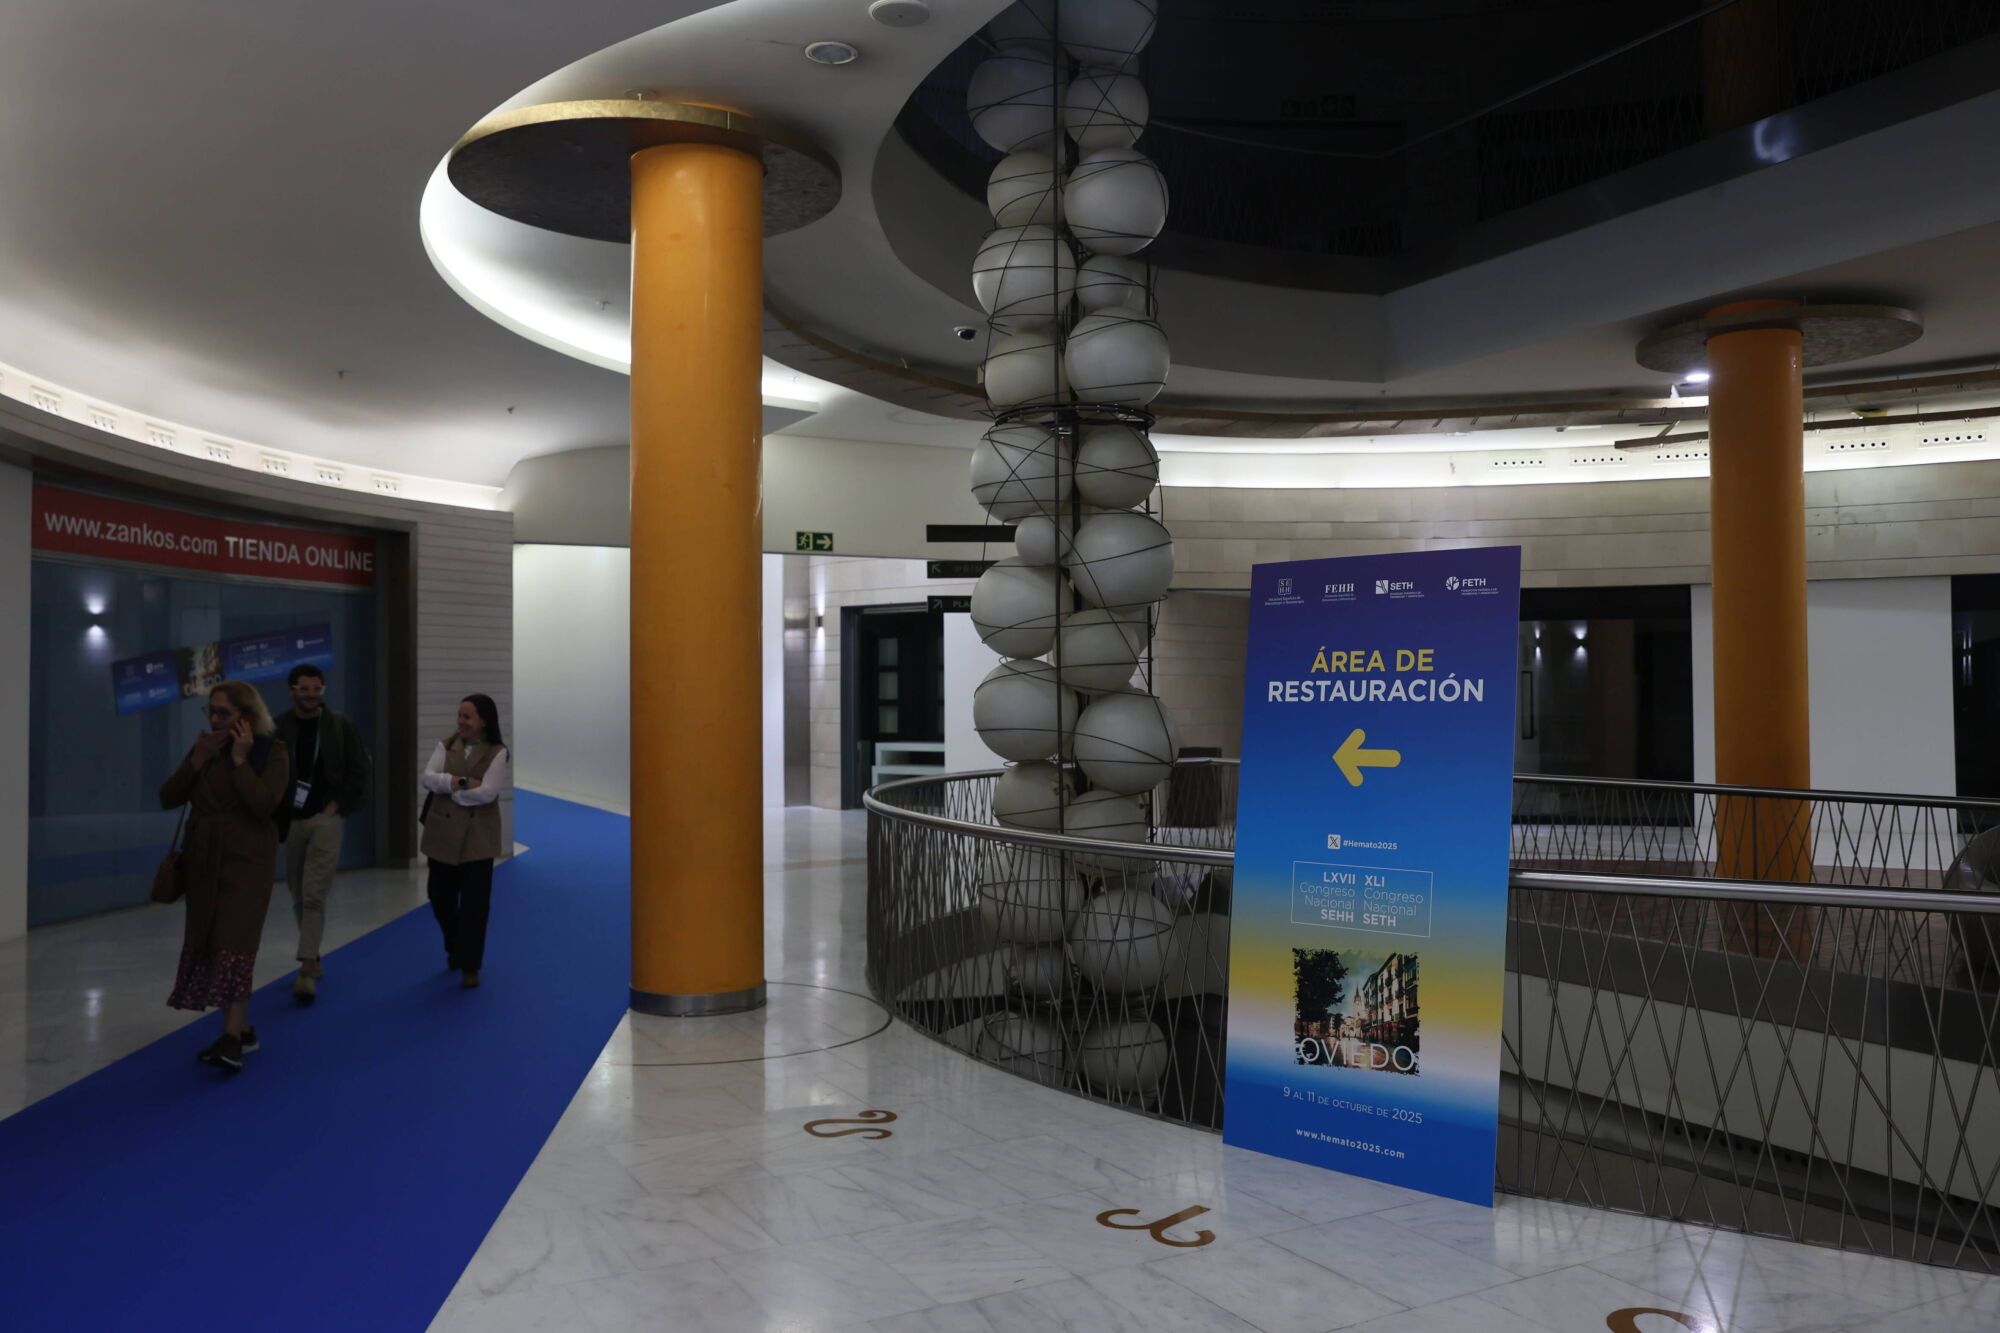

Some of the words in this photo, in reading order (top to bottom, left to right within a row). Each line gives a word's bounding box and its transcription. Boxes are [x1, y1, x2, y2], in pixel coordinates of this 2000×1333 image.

[44, 511, 218, 557] www.zankos.com
[224, 535, 301, 565] TIENDA
[304, 545, 374, 572] ONLINE
[1324, 583, 1355, 594] FEHH
[1390, 581, 1413, 591] SETH
[1462, 578, 1486, 587] FETH
[953, 600, 970, 608] PLA
[1311, 646, 1386, 673] ÁREA
[1396, 649, 1435, 672] DE
[1267, 673, 1485, 702] RESTAURACIÓN
[1343, 839, 1398, 850] #Hemato2025
[1323, 872, 1356, 885] LXVII
[1364, 875, 1385, 887] XLI
[1300, 882, 1356, 898] Congreso
[1364, 888, 1424, 904] Congreso
[1304, 895, 1355, 910] Nacional
[1364, 901, 1416, 916] Nacional
[1321, 909, 1354, 922] SEHH
[1363, 914, 1396, 927] SETH
[1299, 1038, 1415, 1071] OVIEDO
[1283, 1086, 1290, 1097] 9
[1293, 1092, 1304, 1101] AL
[1307, 1092, 1315, 1102] 11
[1318, 1096, 1329, 1105] DE
[1332, 1099, 1373, 1114] OCTUBRE
[1377, 1108, 1389, 1118] DE
[1392, 1108, 1423, 1124] 2025
[1296, 1128, 1405, 1159] www.hemato2025.com
